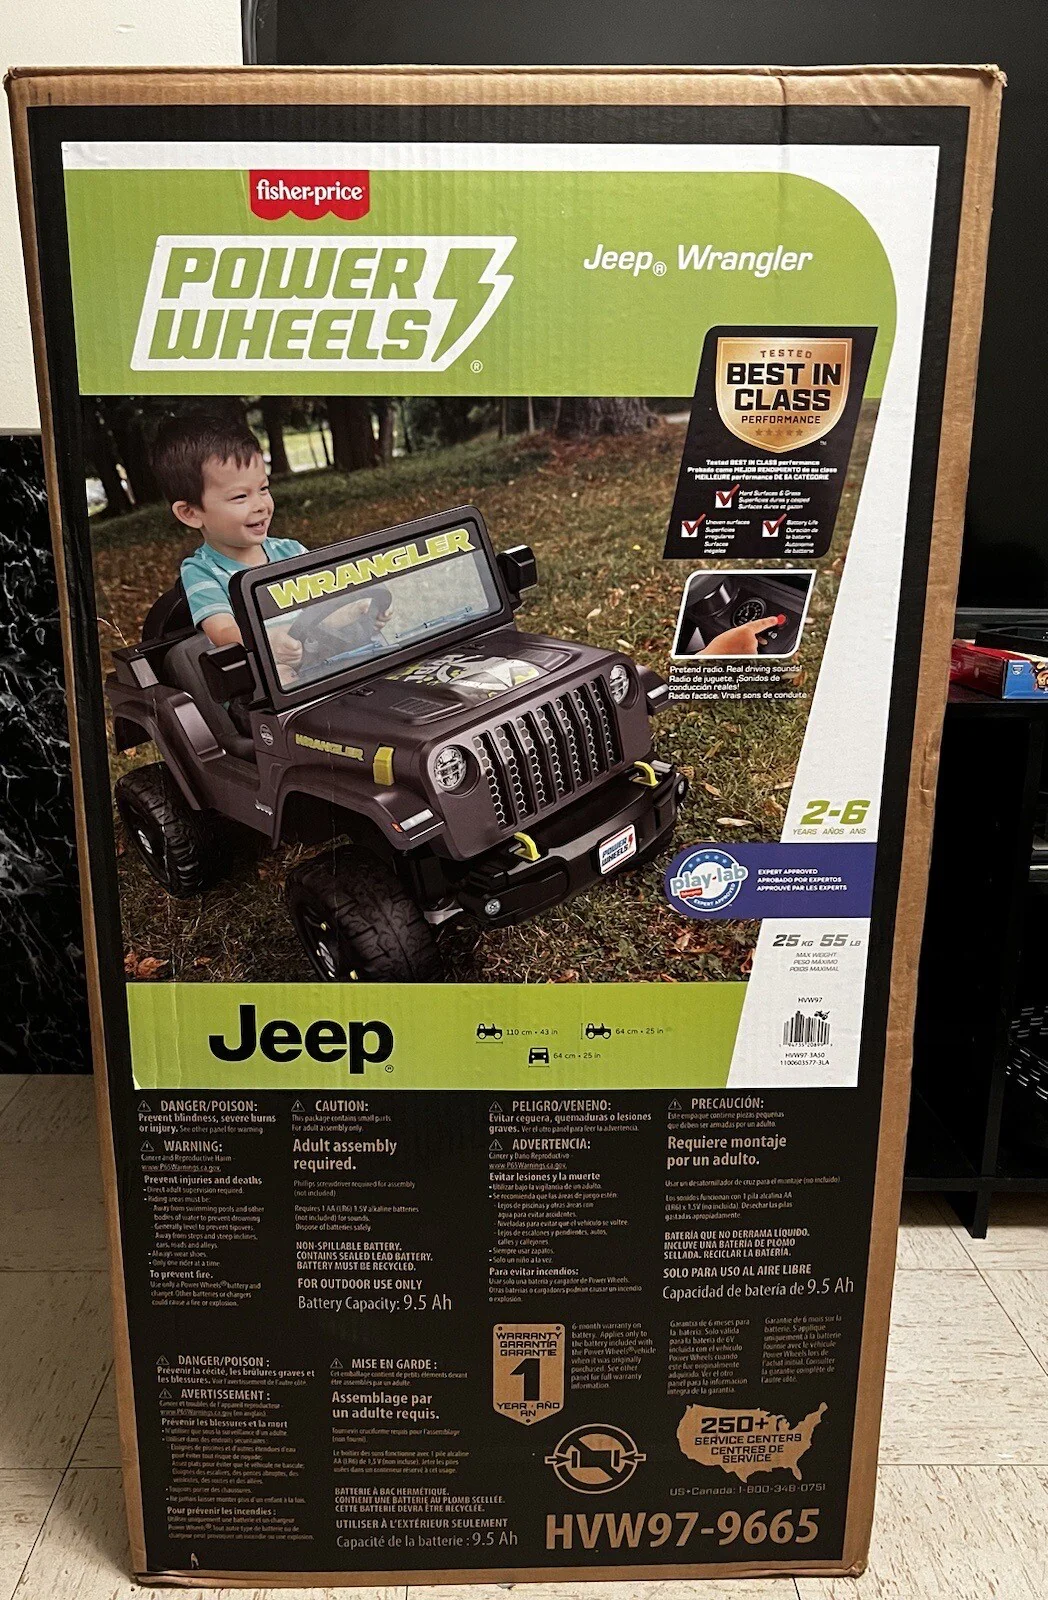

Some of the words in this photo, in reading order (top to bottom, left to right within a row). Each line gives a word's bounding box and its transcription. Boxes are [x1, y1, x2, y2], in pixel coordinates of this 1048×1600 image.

[256, 180, 364, 206] fisher-price
[678, 244, 813, 277] Wrangler
[162, 247, 428, 299] POWER
[148, 310, 432, 362] WHEELS
[760, 350, 812, 358] TESTED
[727, 363, 805, 385] BEST
[813, 363, 841, 385] IN
[735, 389, 830, 411] CLASS
[267, 528, 476, 610] WRANGLER
[295, 733, 364, 761] WRANGLER
[800, 800, 871, 825] 2-6
[822, 827, 845, 835] AÑOS
[602, 837, 628, 859] POWER
[602, 845, 629, 867] WHEELS
[670, 863, 749, 897] play-lab
[693, 899, 714, 907] EXPERT
[713, 883, 736, 906] APPROVED
[773, 934, 801, 946] 25
[820, 934, 848, 946] 55
[506, 1028, 519, 1036] 110
[540, 1028, 549, 1036] 43
[551, 1028, 558, 1036] in
[615, 1027, 625, 1035] 64
[646, 1027, 655, 1035] 25
[657, 1027, 664, 1035] in
[208, 1003, 395, 1074] Jeep
[553, 1051, 563, 1059] 64
[583, 1051, 593, 1059] 25
[161, 1100, 258, 1112] DANGER/POISON:
[315, 1100, 369, 1112] CAUTION:
[513, 1100, 612, 1112] PELIGRO/VENENO:
[691, 1096, 764, 1109] PRECAUCIÓN:
[138, 1113, 172, 1122] Prevent
[174, 1113, 218, 1123] blindness,
[251, 1114, 276, 1122] burns
[150, 1123, 178, 1134] injury.
[164, 1140, 222, 1152] WARNING:
[293, 1138, 330, 1152] Adult
[333, 1139, 397, 1156] assembly
[513, 1138, 591, 1150] ADVERTENCIA:
[668, 1136, 728, 1152] Requiere
[731, 1134, 787, 1150] montaje
[294, 1157, 357, 1173] required.
[667, 1156, 689, 1169] por
[693, 1155, 709, 1166] un
[713, 1152, 760, 1166] adulto.
[296, 1242, 361, 1250] NON-SPILLABLE
[364, 1242, 402, 1250] BATTERY.
[297, 1251, 337, 1260] CONTAINS
[339, 1252, 370, 1260] SEALED
[372, 1252, 393, 1260] LEAD
[395, 1253, 433, 1261] BATTERY.
[297, 1261, 332, 1269] BATTERY
[335, 1262, 358, 1270] MUST
[360, 1262, 370, 1270] BE
[373, 1262, 416, 1271] RECYCLED.
[663, 1268, 688, 1278] SOLO
[691, 1267, 717, 1277] PARA
[720, 1266, 740, 1276] USO
[742, 1266, 754, 1276] AL
[757, 1265, 780, 1275] AIRE
[783, 1264, 811, 1274] LIBRE
[150, 1270, 160, 1278] To
[161, 1271, 194, 1280] prevent
[196, 1270, 213, 1278] fire.
[298, 1278, 318, 1289] FOR
[321, 1279, 370, 1289] OUTDOOR
[373, 1280, 392, 1289] USE
[395, 1280, 423, 1290] ONLY
[663, 1284, 724, 1301] Capacidad
[727, 1284, 741, 1297] de
[745, 1282, 786, 1296] batería
[790, 1282, 804, 1295] de
[807, 1278, 830, 1294] 9.5
[834, 1277, 854, 1294] Ah
[299, 1296, 342, 1312] Battery
[345, 1296, 400, 1313] Capacity:
[403, 1295, 427, 1310] 9.5
[432, 1294, 452, 1310] Ah
[500, 1339, 557, 1348] GARANTÍA
[352, 1359, 377, 1369] MISE
[380, 1359, 394, 1369] EN
[396, 1359, 431, 1369] GARDE
[510, 1358, 540, 1401] 1
[332, 1391, 408, 1406] Assemblage
[411, 1394, 432, 1406] par
[537, 1401, 560, 1409] AÑO
[332, 1410, 348, 1418] un
[352, 1408, 393, 1419] adulte
[396, 1408, 439, 1422] requis.
[701, 1416, 768, 1434] 250+
[695, 1436, 744, 1446] SERVICE
[746, 1434, 802, 1444] CENTERS
[711, 1446, 766, 1455] CENTRES
[722, 1454, 772, 1463] SERVICE
[738, 1484, 826, 1494] 1-800-348-0751
[546, 1508, 820, 1550] HVW97-9665
[337, 1535, 384, 1550] Capacité
[388, 1536, 401, 1547] de
[405, 1536, 415, 1546] la
[418, 1535, 463, 1546] batterie
[472, 1532, 494, 1545] 9.5
[499, 1531, 518, 1545] Ah
